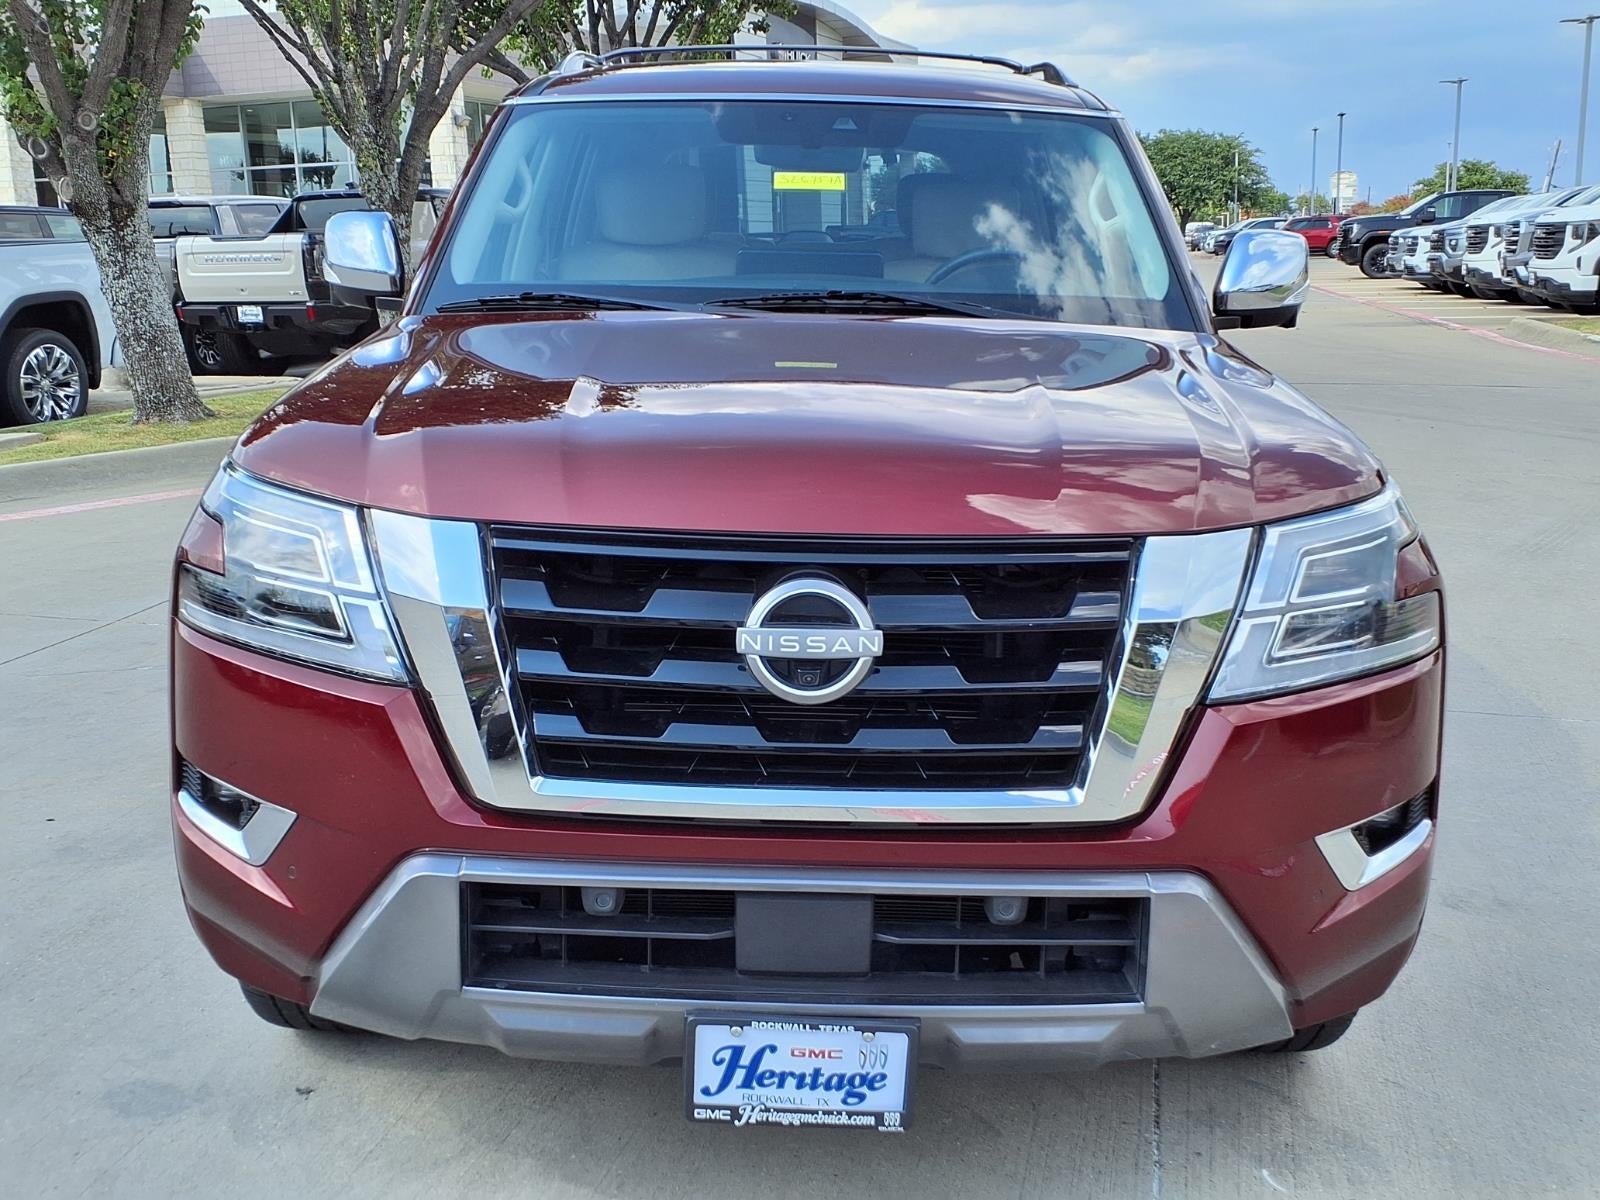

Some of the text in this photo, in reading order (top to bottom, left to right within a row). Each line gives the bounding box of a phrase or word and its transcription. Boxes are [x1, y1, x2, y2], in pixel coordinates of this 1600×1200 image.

[741, 633, 879, 653] NISSAN
[817, 1024, 855, 1033] TEXAS
[790, 1047, 843, 1059] GMC
[700, 1043, 887, 1106] Heritage
[816, 1097, 830, 1107] TX
[694, 1104, 875, 1126] GMC Heritagegmcbuick.com
